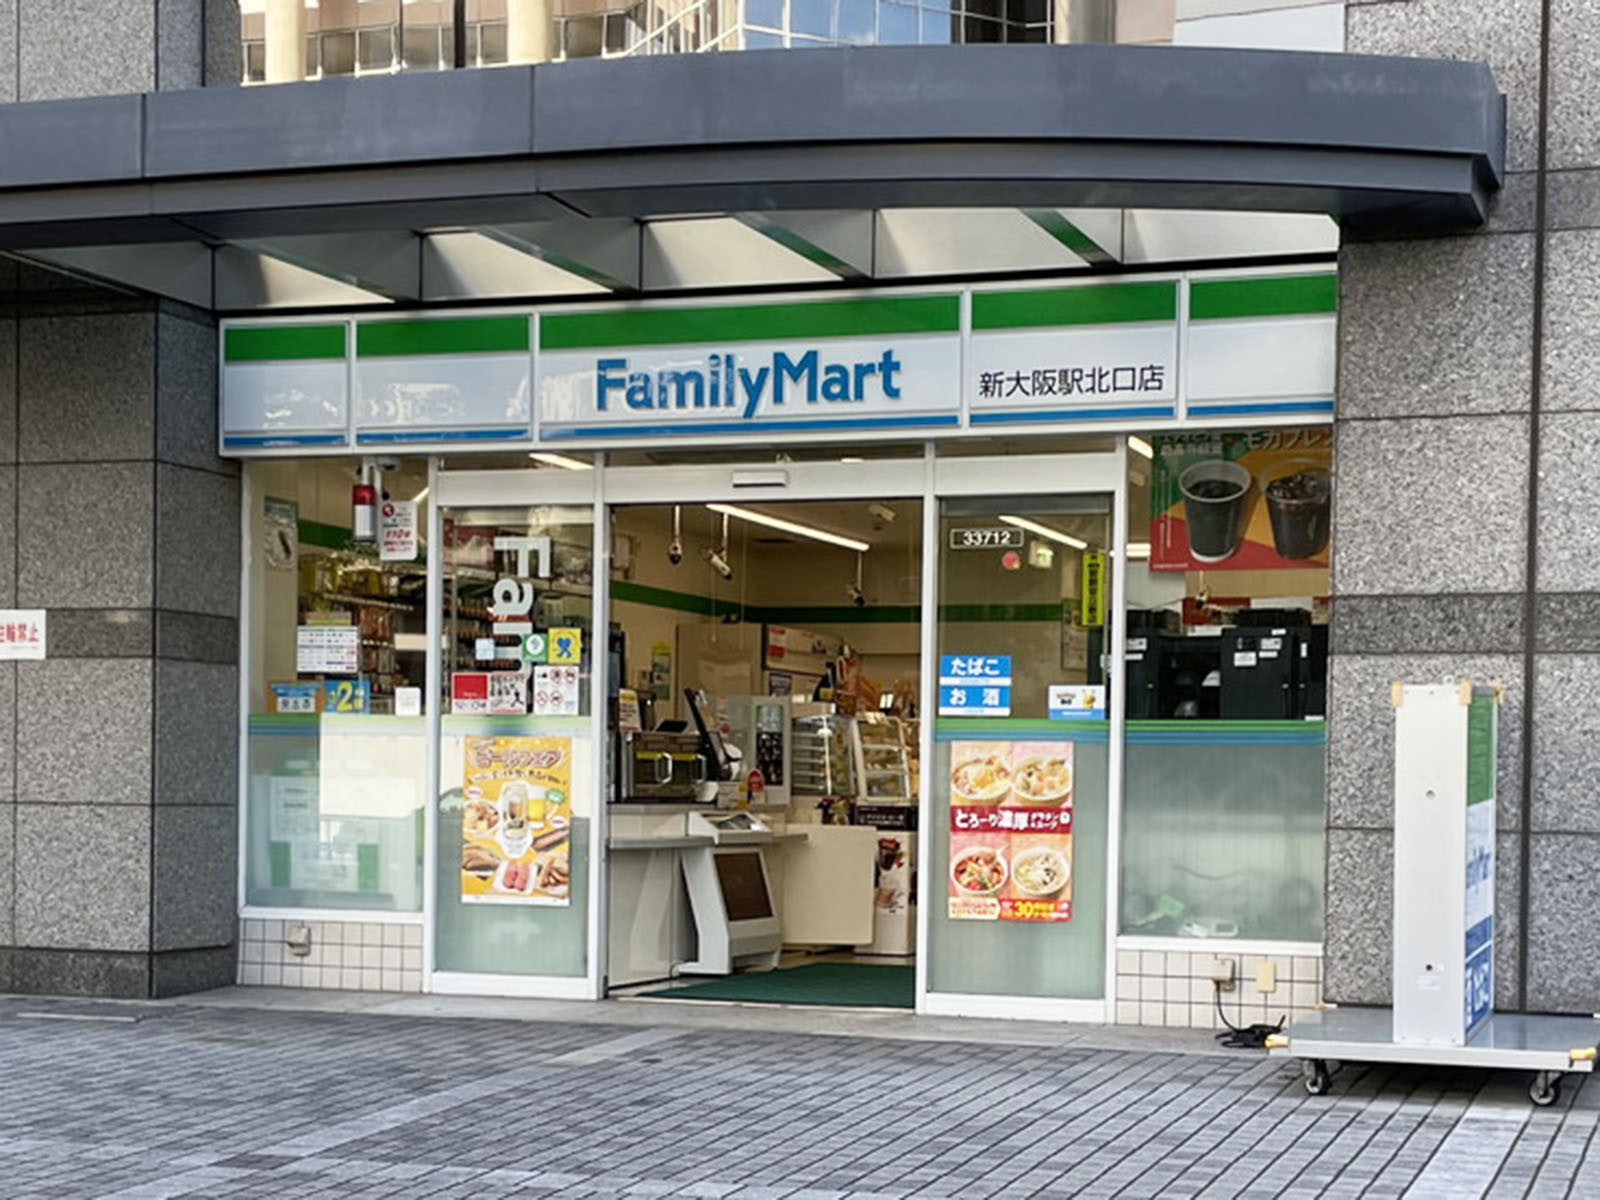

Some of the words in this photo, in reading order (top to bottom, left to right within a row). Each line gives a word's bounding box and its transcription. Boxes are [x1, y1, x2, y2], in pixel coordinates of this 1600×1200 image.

[596, 349, 901, 418] FamilyMart
[979, 365, 1165, 397] 新大阪駅北口店
[963, 531, 1011, 545] 33712
[951, 657, 1000, 676] たばこ
